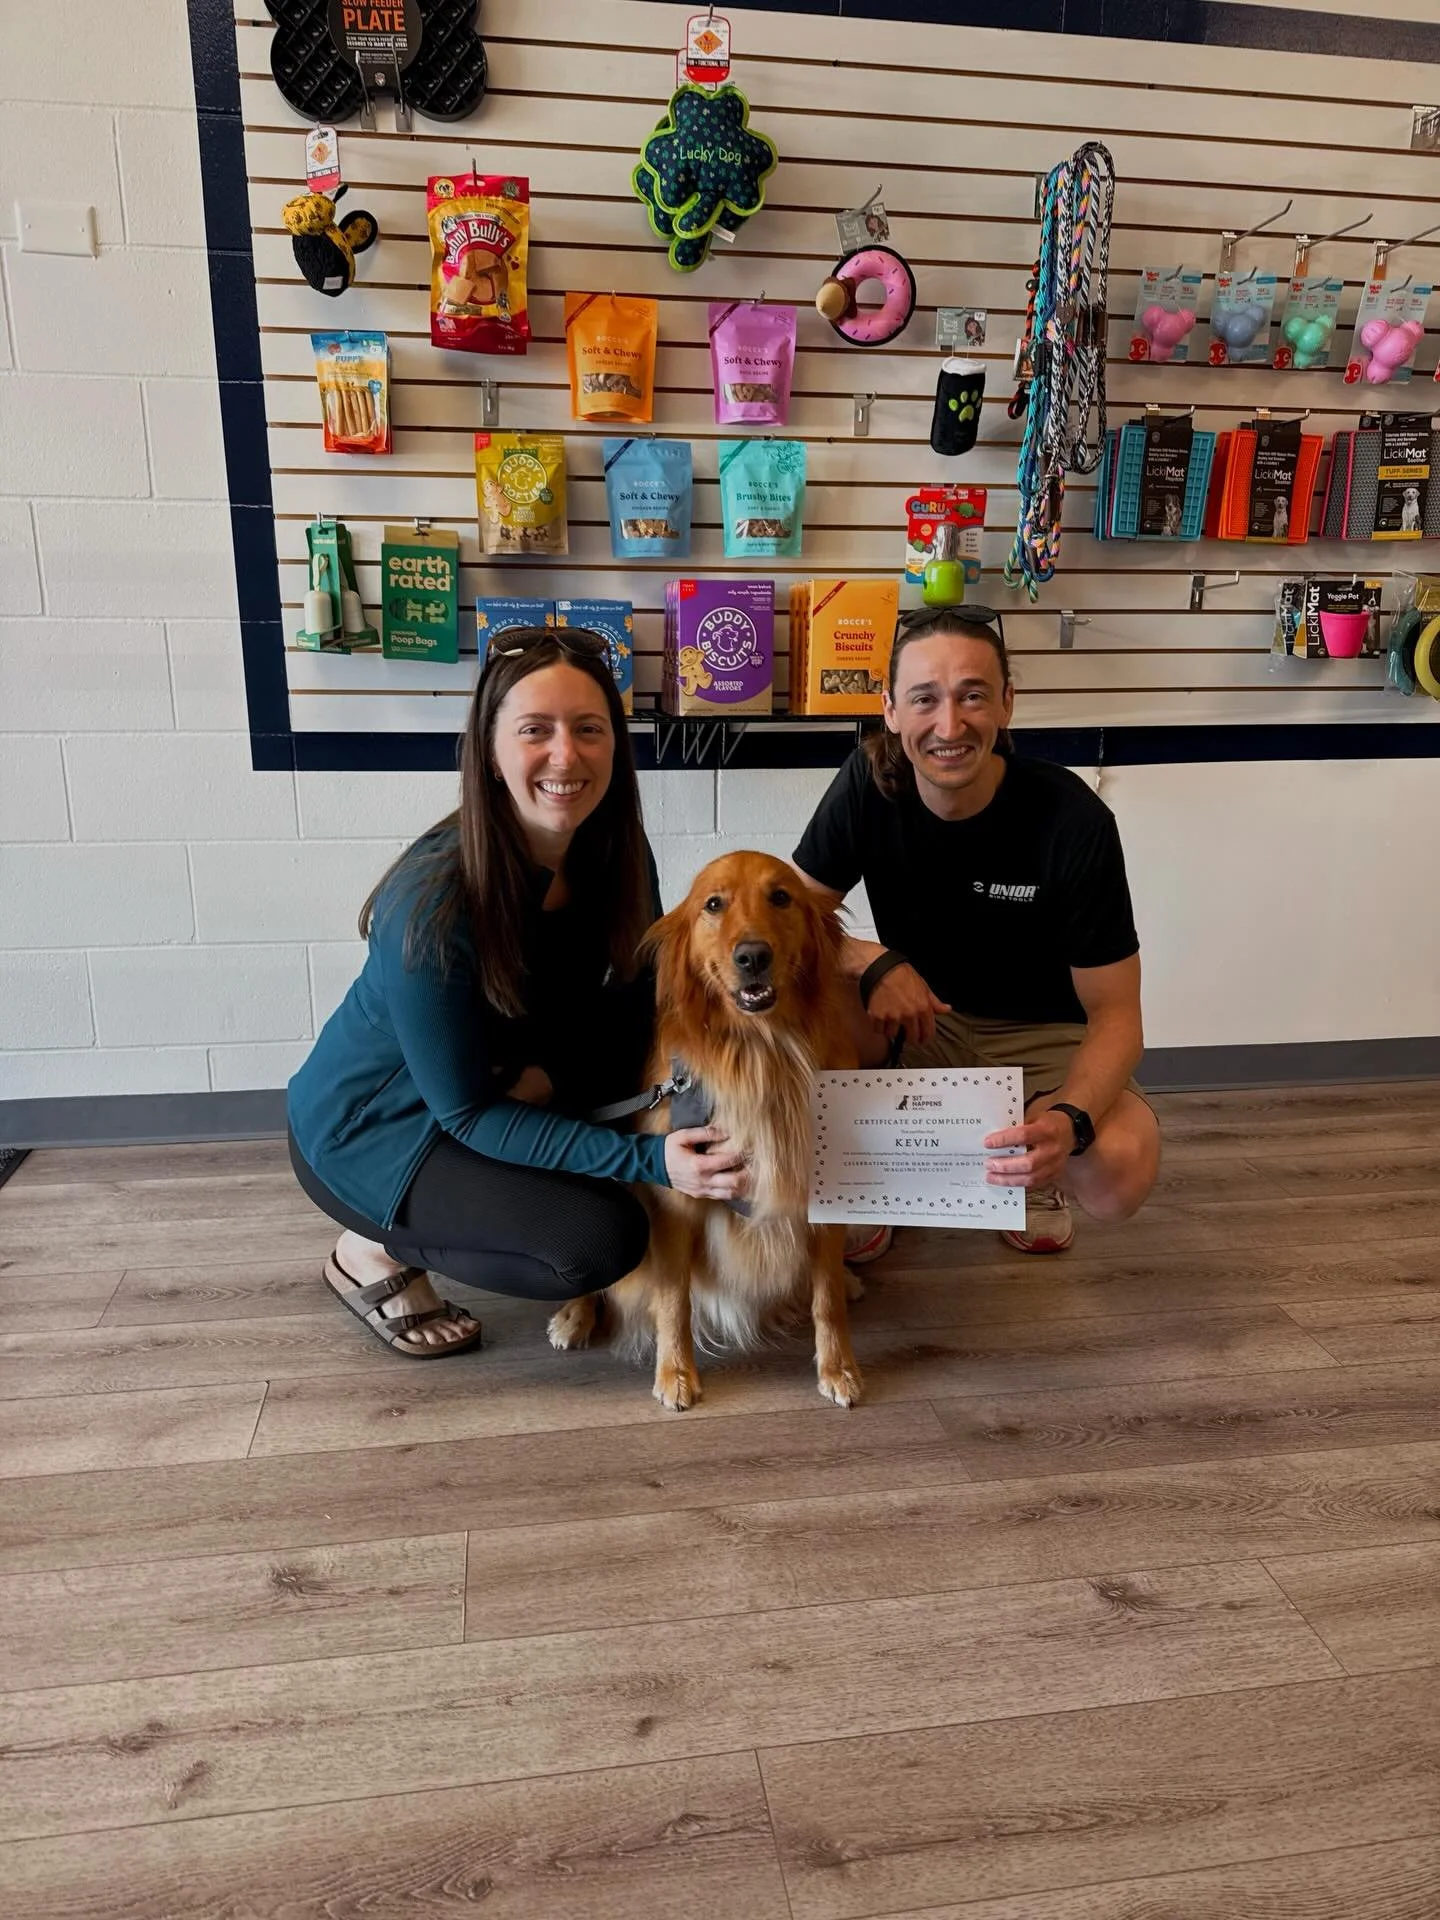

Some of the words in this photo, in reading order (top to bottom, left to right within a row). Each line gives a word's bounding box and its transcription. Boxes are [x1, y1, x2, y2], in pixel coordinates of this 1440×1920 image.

[343, 8, 405, 31] PLATE
[680, 144, 715, 164] Lucky
[719, 146, 742, 167] Dog
[469, 220, 510, 249] Bully's
[582, 346, 601, 355] Soft
[603, 347, 611, 356] &
[613, 348, 643, 361] Chewy
[724, 356, 742, 365] Soft
[744, 357, 752, 365] &
[754, 358, 783, 368] Chewy
[1383, 447, 1427, 459] LickiMat
[503, 455, 541, 473] BUDDY
[1254, 469, 1292, 481] LickiMat
[503, 481, 545, 502] SOFTIES
[619, 492, 638, 501] Soft
[640, 493, 648, 501] &
[650, 493, 681, 503] Chewy
[736, 493, 768, 503] Brushy
[770, 493, 792, 502] Bites
[388, 555, 451, 575] earth
[389, 572, 451, 592] rated
[1327, 592, 1348, 602] Yoggie
[1348, 593, 1360, 601] Pot
[704, 611, 751, 632] BUDDY
[837, 618, 873, 626] BOCCE'S
[1307, 586, 1321, 646] LickiMat
[391, 635, 415, 646] Poop
[415, 636, 438, 648] Bags
[833, 631, 876, 642] Crunchy
[701, 640, 753, 667] BISCUITS
[835, 642, 874, 652] Biscuits
[713, 680, 744, 688] ASSORTED
[989, 883, 1037, 898] UNIOR
[895, 1138, 940, 1147] KEVIN
